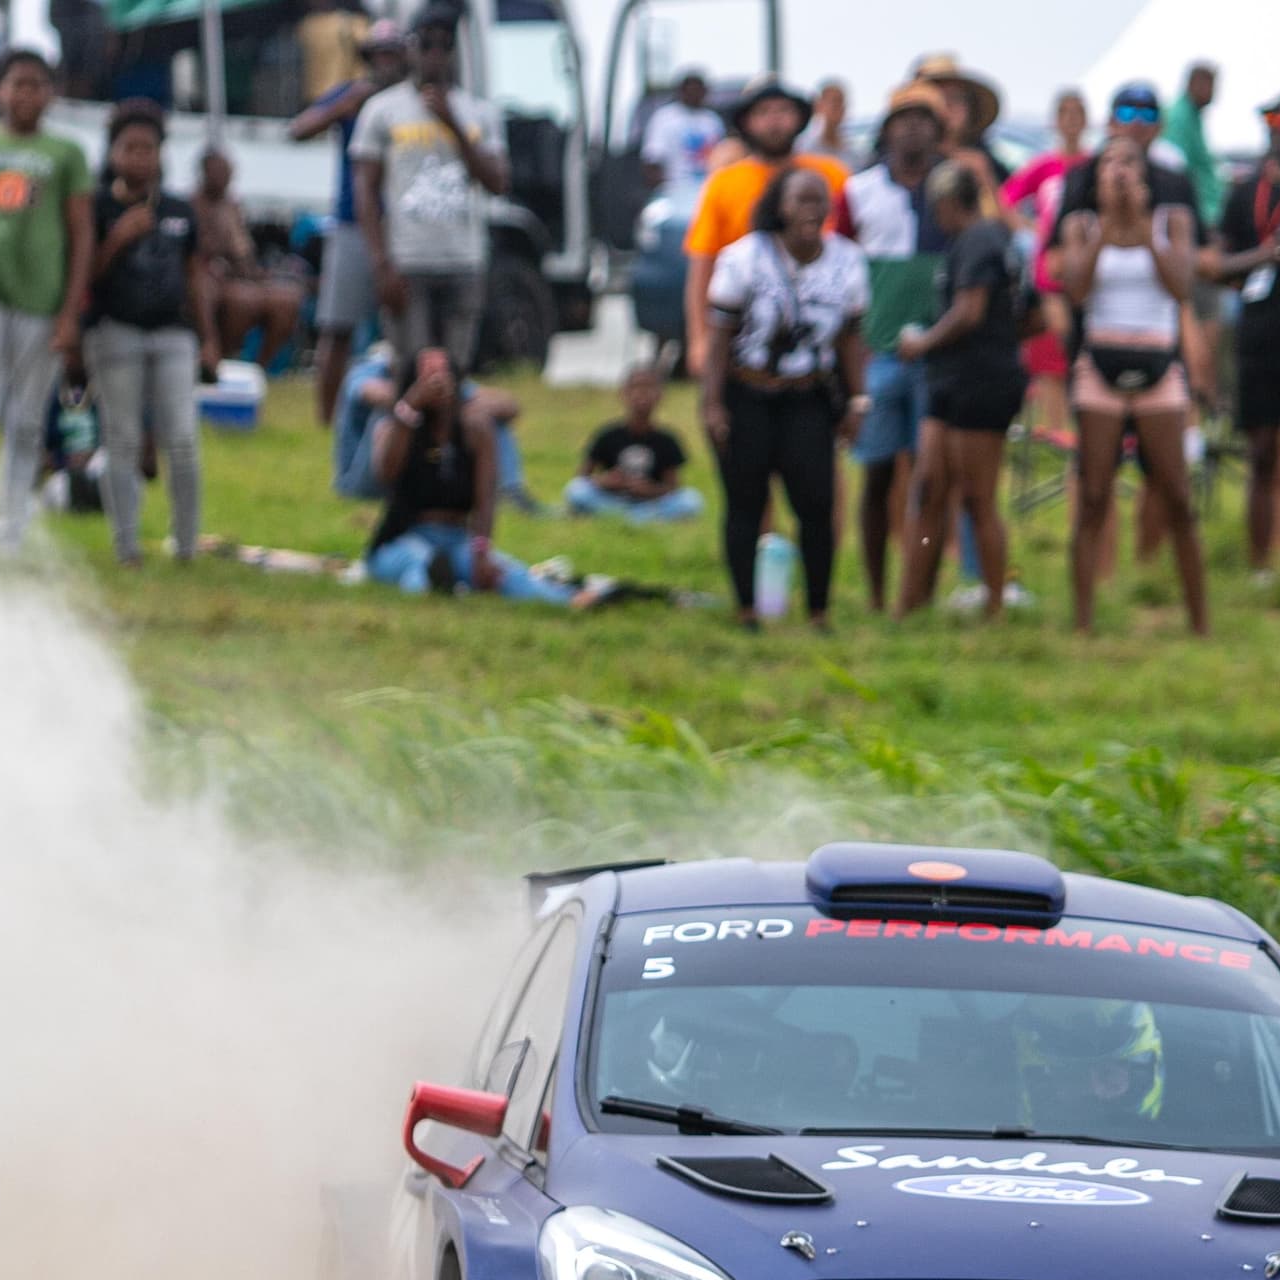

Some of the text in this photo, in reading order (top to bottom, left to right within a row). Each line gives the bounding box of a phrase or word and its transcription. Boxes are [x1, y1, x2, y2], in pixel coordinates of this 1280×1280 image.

[642, 918, 1253, 970] FORD PERFORMANCE
[641, 956, 676, 980] 5
[822, 1145, 1202, 1186] Sandals
[946, 1176, 1100, 1200] Ford
